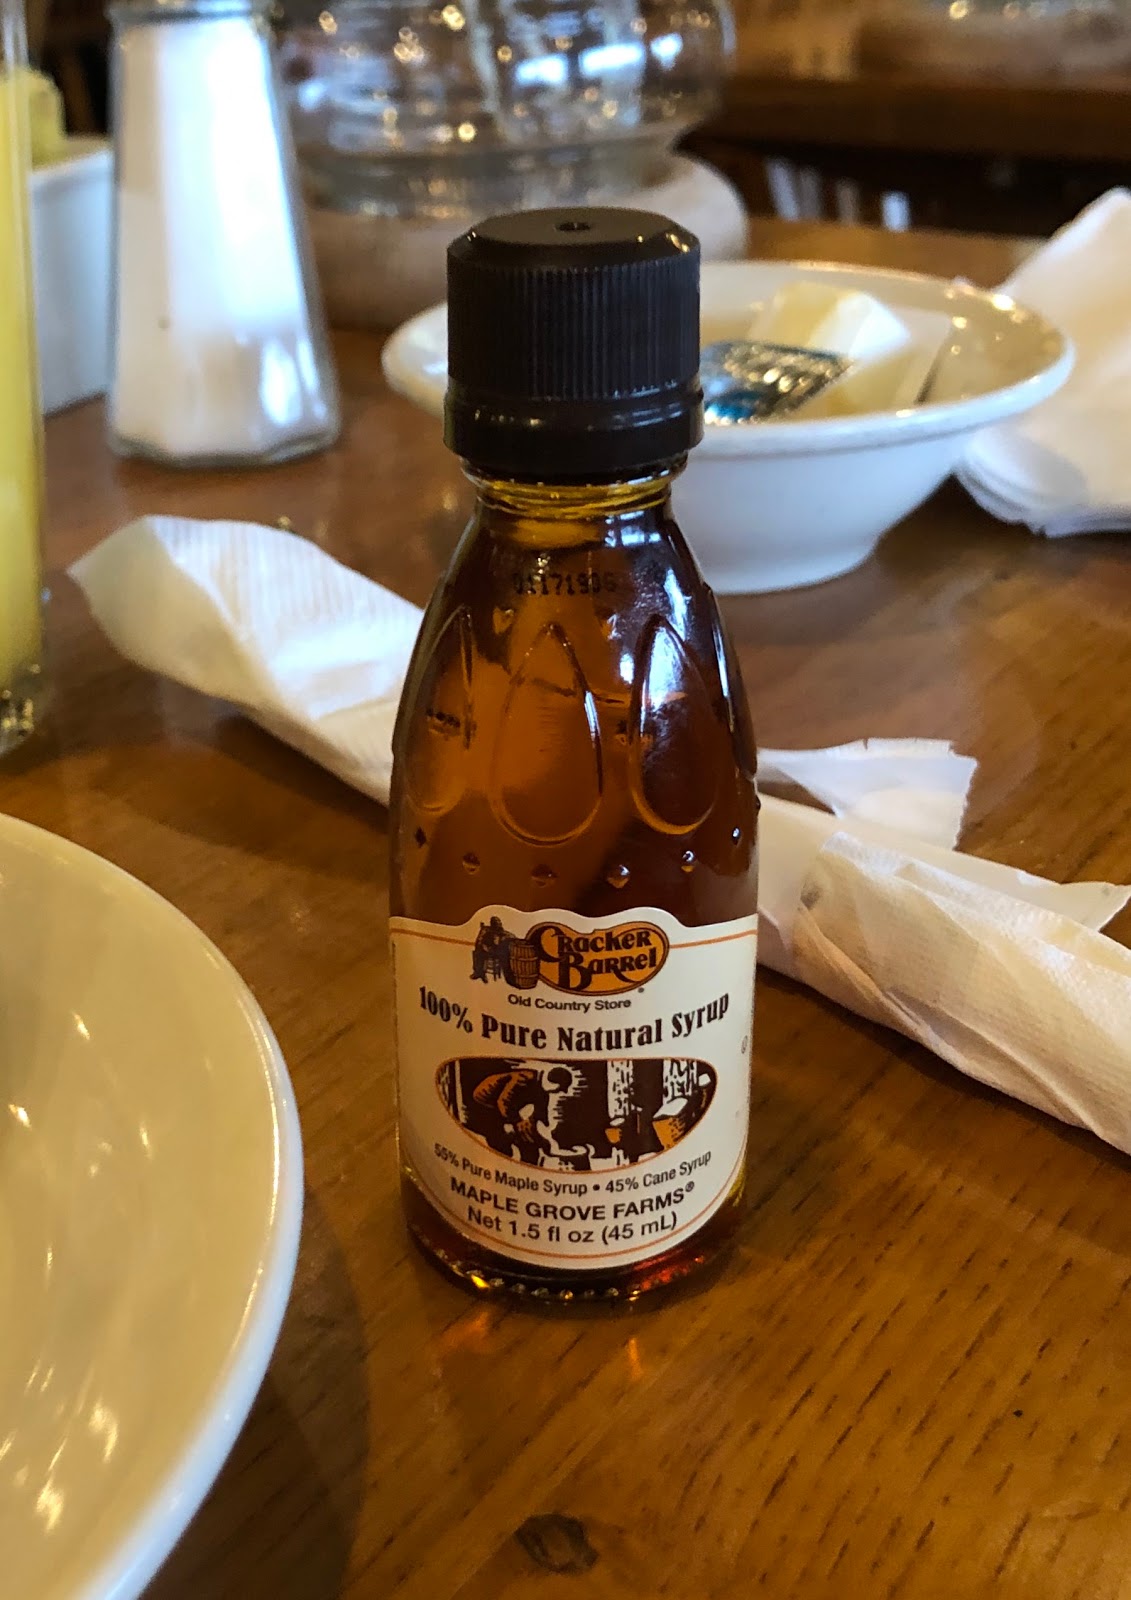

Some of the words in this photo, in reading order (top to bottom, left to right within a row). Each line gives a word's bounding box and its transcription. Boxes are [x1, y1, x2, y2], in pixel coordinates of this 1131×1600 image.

[419, 986, 474, 1034] 100%
[481, 1013, 547, 1050] Pure
[557, 1018, 663, 1052] Natural
[671, 993, 730, 1040] Syrup
[507, 993, 533, 1008] Old
[535, 998, 591, 1014] Country
[594, 998, 632, 1011] Store
[434, 1143, 459, 1167] 55%
[462, 1158, 492, 1180] Pure
[495, 1170, 539, 1191] Maple
[543, 1178, 588, 1197] Syrup
[605, 1177, 640, 1194] 45%
[643, 1168, 676, 1188] Cane
[679, 1151, 713, 1178] Syrup
[450, 1176, 519, 1214] MAPLE
[525, 1202, 606, 1221] GROVE
[466, 1204, 502, 1232] Net
[508, 1219, 541, 1240] 1.5
[547, 1226, 562, 1243] fl
[567, 1230, 595, 1244] oz
[601, 1225, 635, 1246] (45
[640, 1211, 677, 1233] mL)
